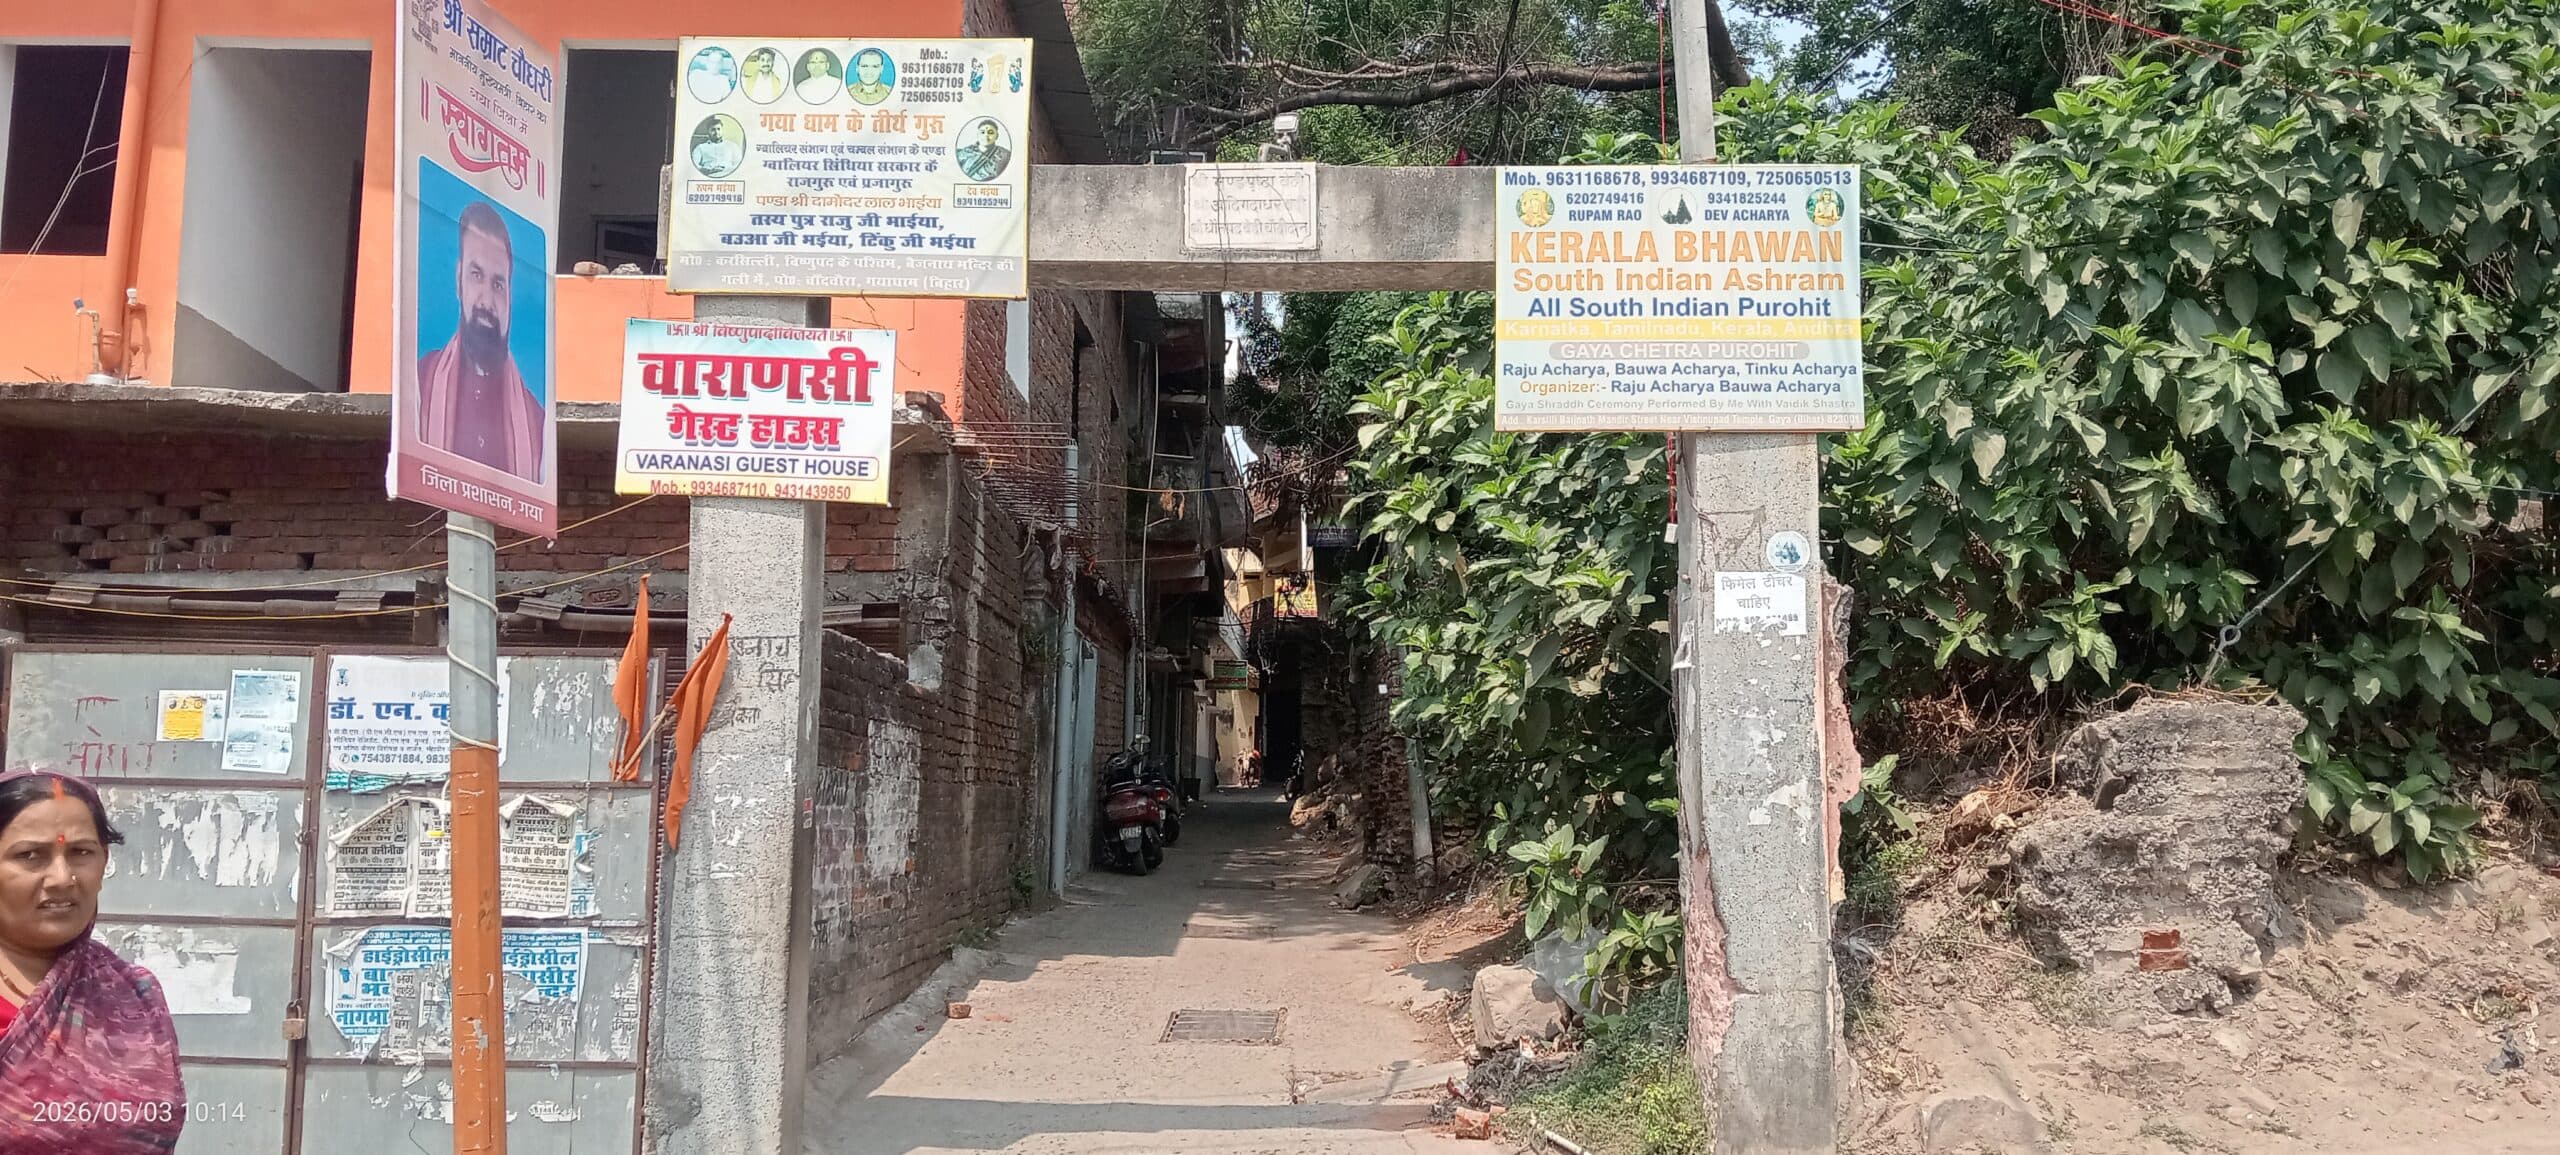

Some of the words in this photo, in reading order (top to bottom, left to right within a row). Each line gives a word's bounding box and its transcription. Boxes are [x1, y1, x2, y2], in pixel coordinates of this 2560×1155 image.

[466, 16, 510, 71] सम्राट
[919, 48, 949, 60] Mob.:
[901, 63, 965, 74] 9631168678
[901, 77, 964, 89] 9934687109
[901, 91, 963, 103] 7250650513
[760, 113, 797, 132] गया
[804, 114, 840, 133] धाम
[845, 109, 866, 133] के
[871, 109, 908, 134] तीर्थ
[877, 160, 921, 172] सरकार
[1505, 171, 1541, 186] Mob.
[1546, 171, 1646, 187] 9631168678,
[1651, 171, 1751, 187] 9934687109,
[1756, 171, 1852, 185] 7250650513
[1566, 193, 1644, 204] 6202749416
[1707, 192, 1786, 204] 9341825244
[791, 214, 816, 230] पुत्र
[858, 213, 882, 227] जी
[1569, 209, 1613, 221] RUPAM
[1617, 209, 1642, 221] RAO
[1704, 209, 1728, 221] DEV
[1732, 209, 1790, 221] ACHARYA
[772, 231, 798, 246] जी
[900, 233, 926, 249] जी
[1510, 231, 1660, 263] KERALA
[1674, 230, 1843, 263] BHAWAN
[1513, 268, 1604, 292] South
[1615, 268, 1712, 291] Indian
[1723, 267, 1845, 291] Ashram
[1528, 298, 1560, 317] All
[1569, 297, 1643, 317] South
[1652, 297, 1729, 317] Indian
[1738, 297, 1831, 316] Purohit
[1783, 320, 1855, 336] Andhra
[1560, 343, 1614, 359] GAYA
[1619, 343, 1702, 359] CHETRA
[1707, 343, 1798, 359] PUROHIT
[637, 347, 879, 404] वाराणसी
[1503, 364, 1537, 379] Raju
[1541, 363, 1610, 378] Acharya,
[1615, 363, 1667, 376] Bauwa
[1671, 363, 1740, 378] Acharya,
[1745, 363, 1788, 375] Tinku
[1792, 363, 1857, 378] Acharya
[1611, 381, 1646, 395] Raju
[1650, 381, 1715, 395] Acharya
[1719, 380, 1772, 393] Bauwa
[1776, 380, 1841, 395] Acharya
[1505, 400, 1534, 411] Gaya
[1587, 400, 1644, 411] Ceremony
[1647, 399, 1706, 409] Performed
[1709, 399, 1724, 410] By
[1746, 399, 1773, 409] With
[666, 404, 742, 442] गेस्ट
[748, 413, 844, 447] हाउस
[636, 454, 731, 472] VARANASI
[735, 456, 799, 473] GUEST
[804, 459, 870, 477] HOUSE
[420, 464, 458, 495] जिला
[460, 481, 517, 517] प्रशासन,
[519, 500, 544, 523] गया
[774, 485, 851, 500] 9431439850
[1762, 573, 1793, 588] टीचर
[1736, 594, 1770, 609] चाहिए
[328, 696, 364, 720] डॉ.
[372, 702, 422, 720] एन.
